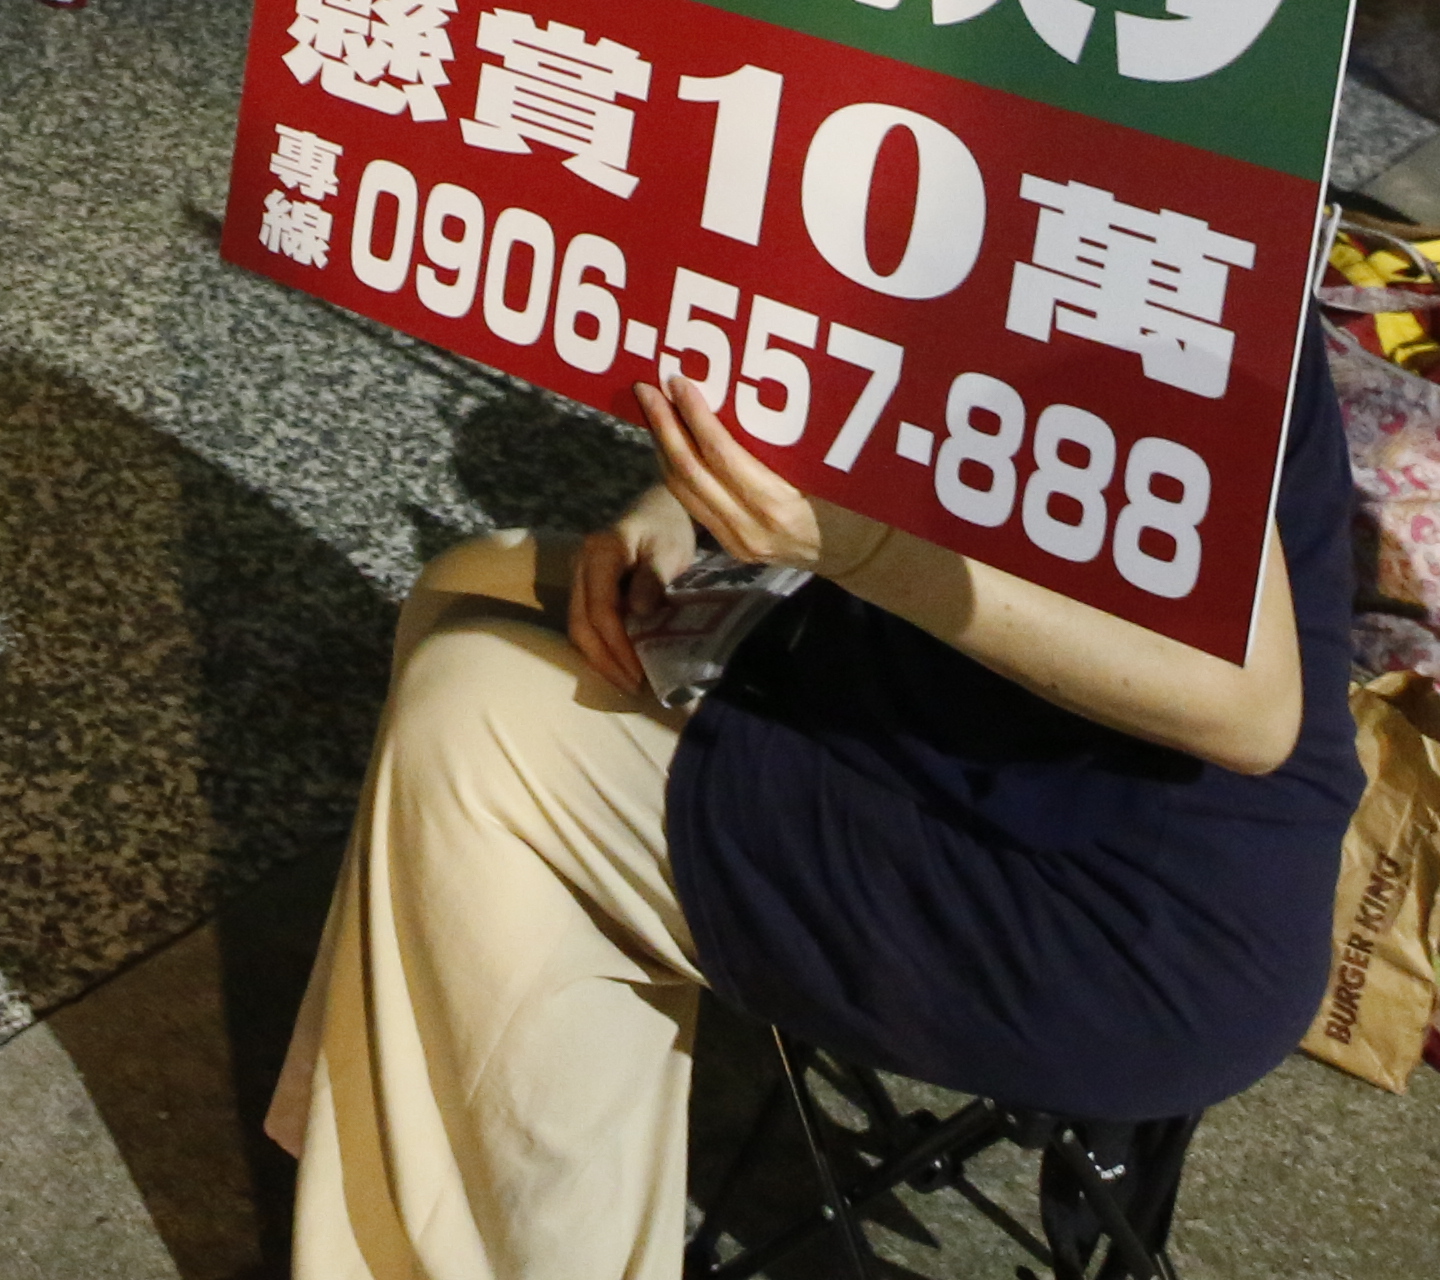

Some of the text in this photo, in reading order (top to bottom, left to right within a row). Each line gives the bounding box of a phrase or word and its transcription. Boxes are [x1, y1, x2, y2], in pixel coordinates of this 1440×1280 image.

[258, 122, 344, 270] 專線
[350, 158, 1212, 601] 0906-557-888
[1325, 851, 1402, 1045] BURGER KING
